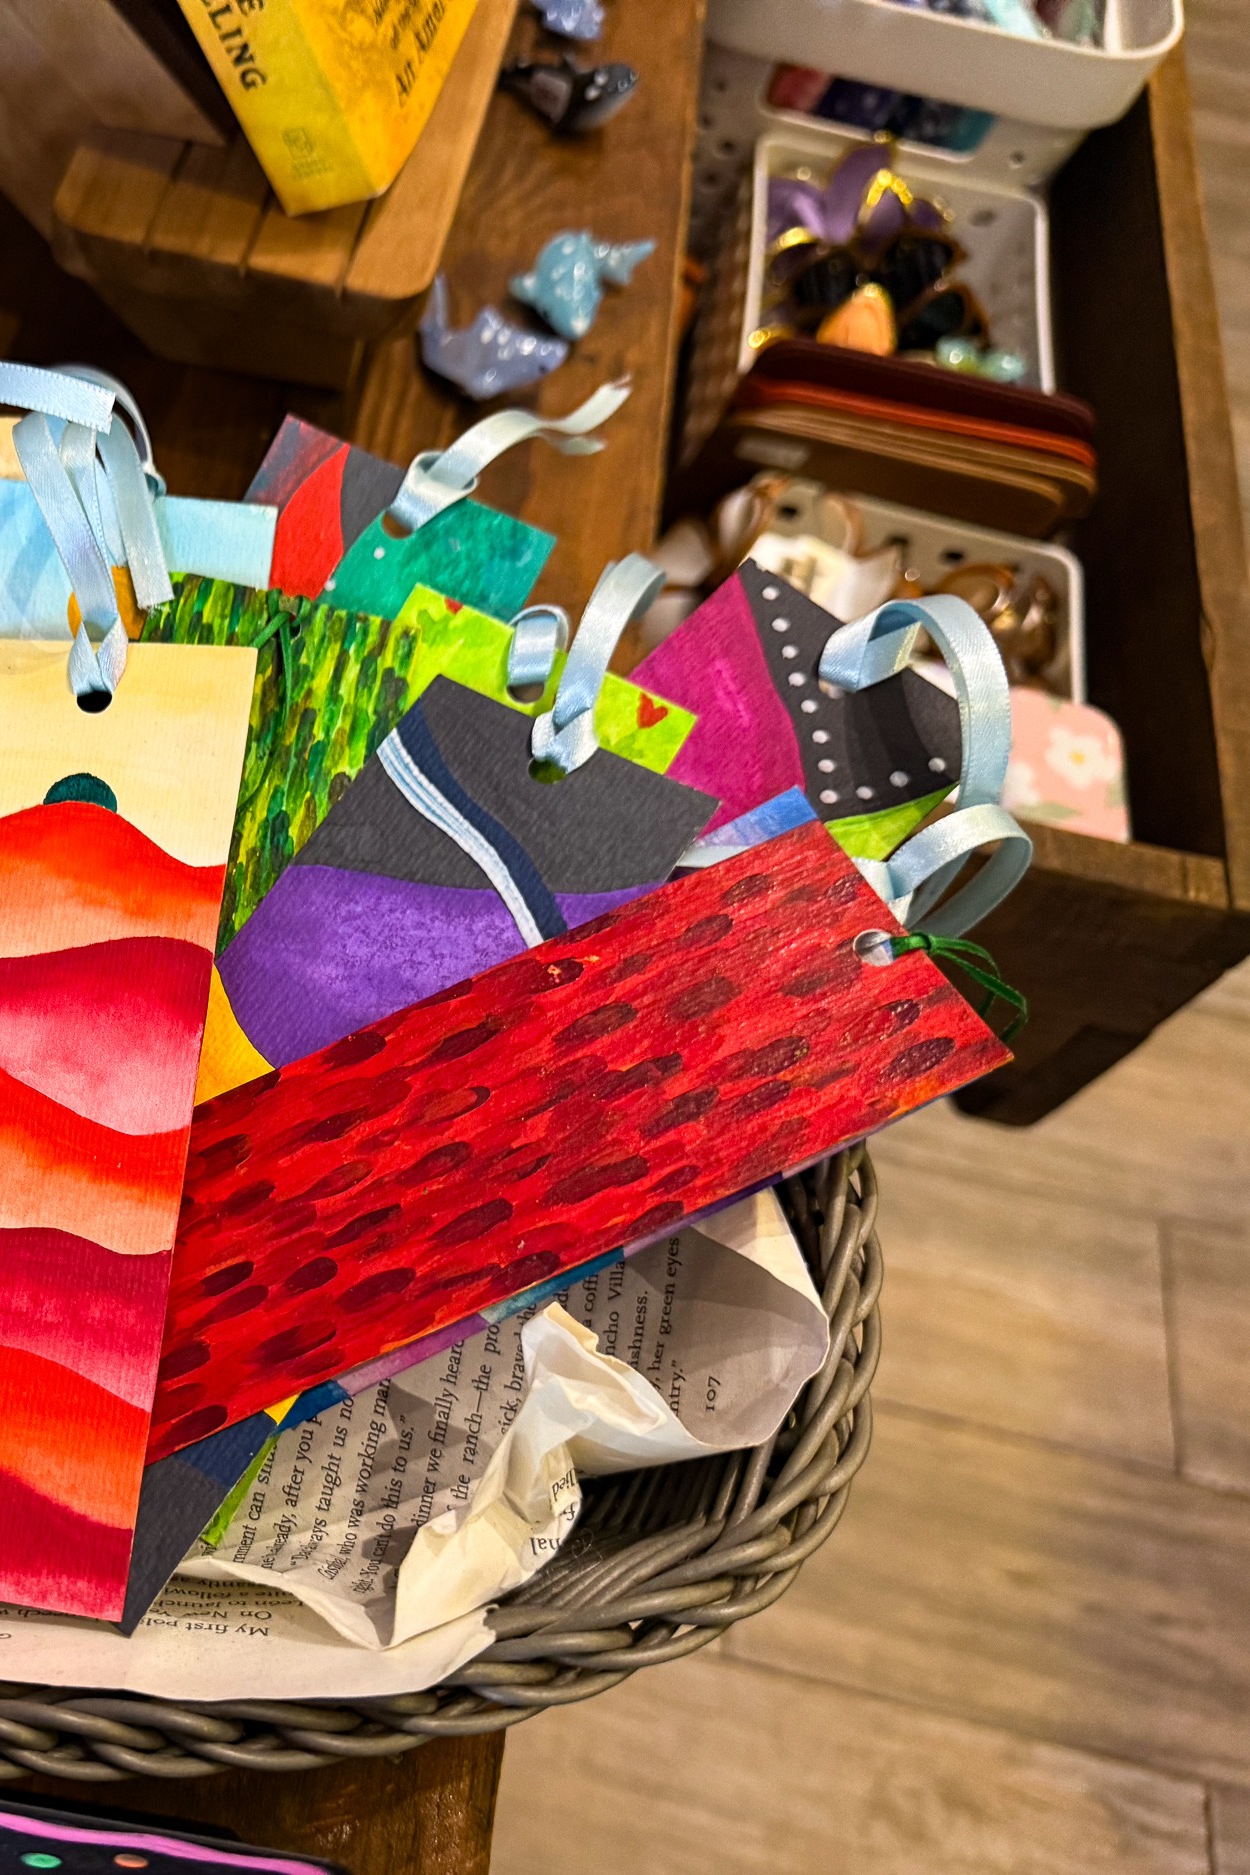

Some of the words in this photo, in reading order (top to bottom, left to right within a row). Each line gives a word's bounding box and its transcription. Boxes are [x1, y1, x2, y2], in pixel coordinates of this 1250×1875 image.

[202, 0, 266, 91] LING
[667, 1237, 683, 1277] eyes
[608, 1261, 625, 1301] Villa
[660, 1287, 676, 1335] green
[603, 1311, 620, 1356] ncho
[627, 1290, 648, 1370] ishness.
[648, 1341, 665, 1372] her
[668, 1359, 686, 1417] ntry.”
[706, 1376, 721, 1412] 107
[427, 1390, 458, 1445] finally
[282, 1465, 305, 1508] after
[296, 1428, 315, 1464] you
[316, 1453, 342, 1512] taught
[333, 1425, 348, 1449] us
[355, 1421, 387, 1496] working
[391, 1455, 407, 1474] to
[426, 1448, 442, 1472] we
[383, 1478, 402, 1514] this
[410, 1477, 437, 1527] dinner
[450, 1473, 471, 1500] the
[249, 1491, 266, 1521] can
[348, 1499, 365, 1532] was
[376, 1513, 396, 1538] do
[339, 1532, 357, 1559] who
[184, 1622, 229, 1635] first
[235, 1623, 271, 1637] My
[240, 1610, 272, 1621] On
